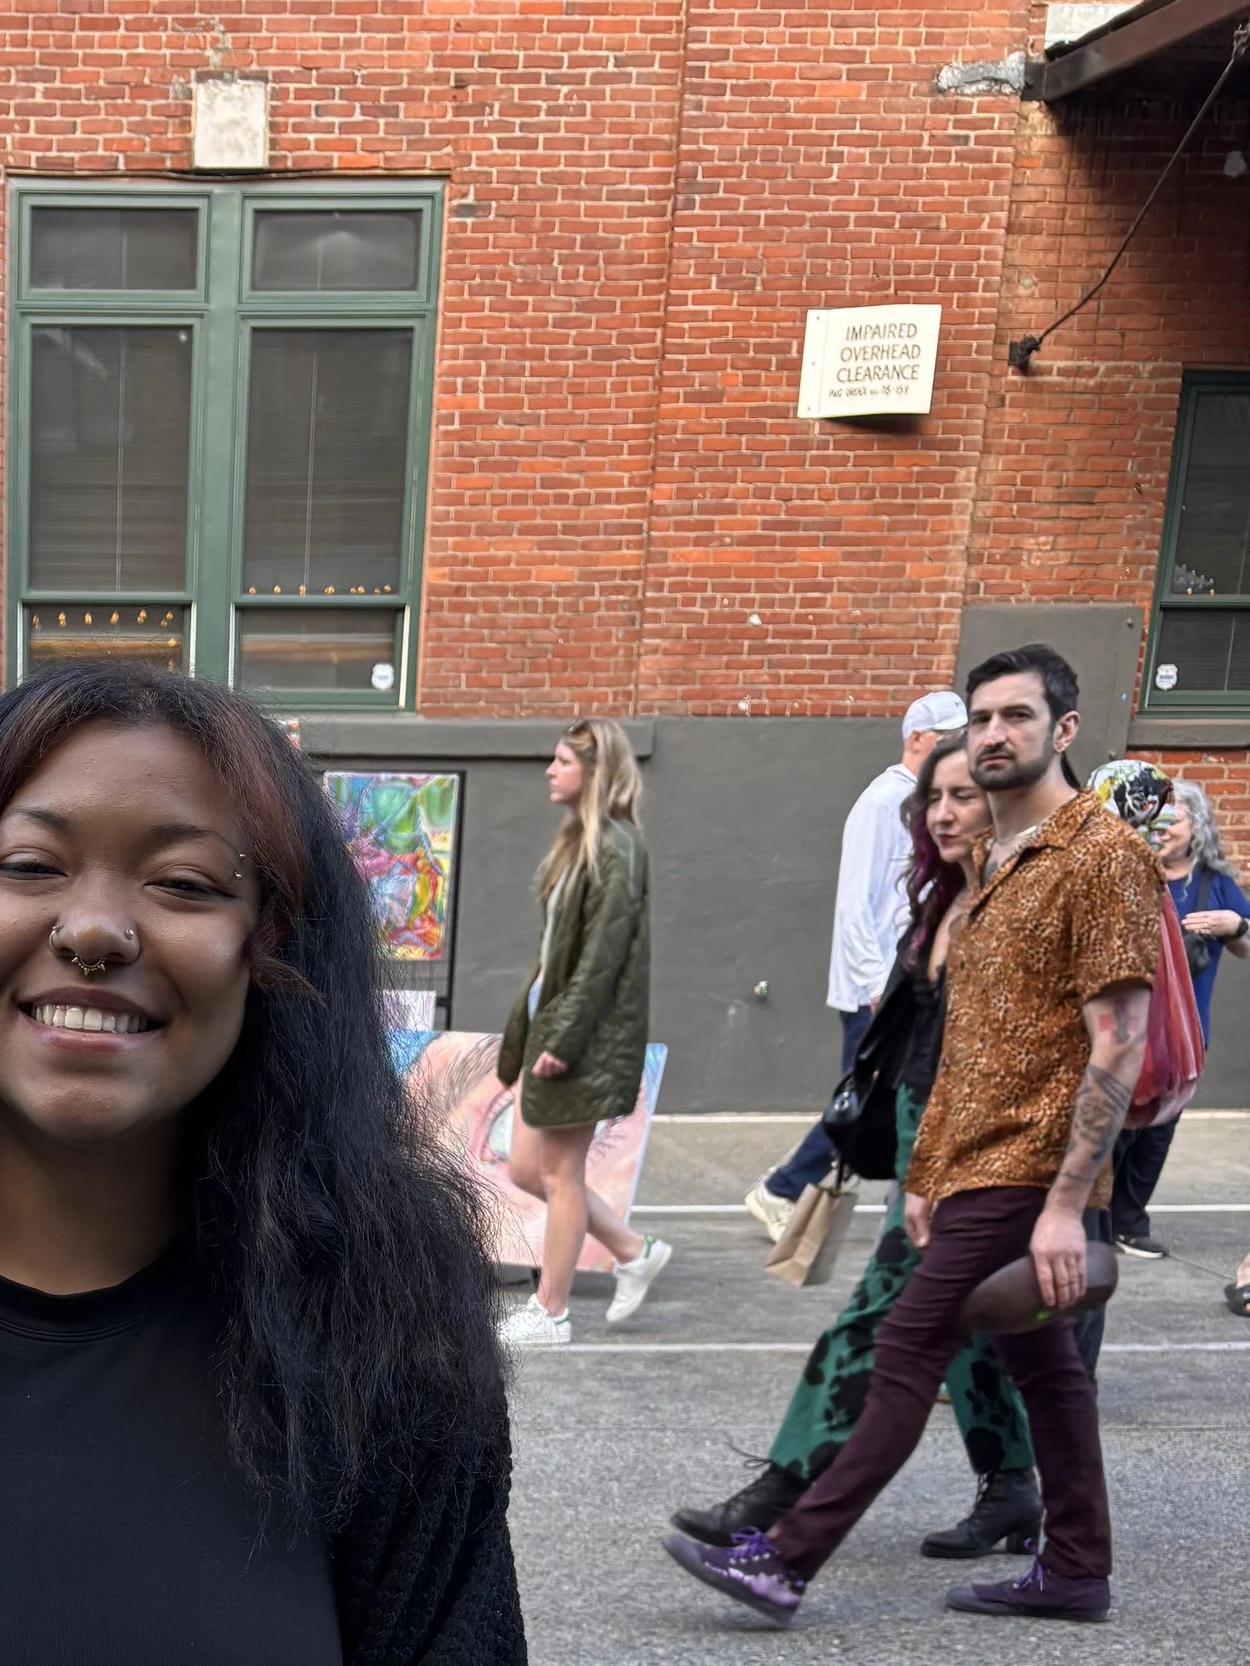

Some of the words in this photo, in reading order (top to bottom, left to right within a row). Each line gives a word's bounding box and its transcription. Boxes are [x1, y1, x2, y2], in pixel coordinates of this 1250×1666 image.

[845, 322, 918, 341] IMPAIRED
[840, 343, 921, 362] OVERHEAD
[836, 363, 920, 383] CLEARANCE
